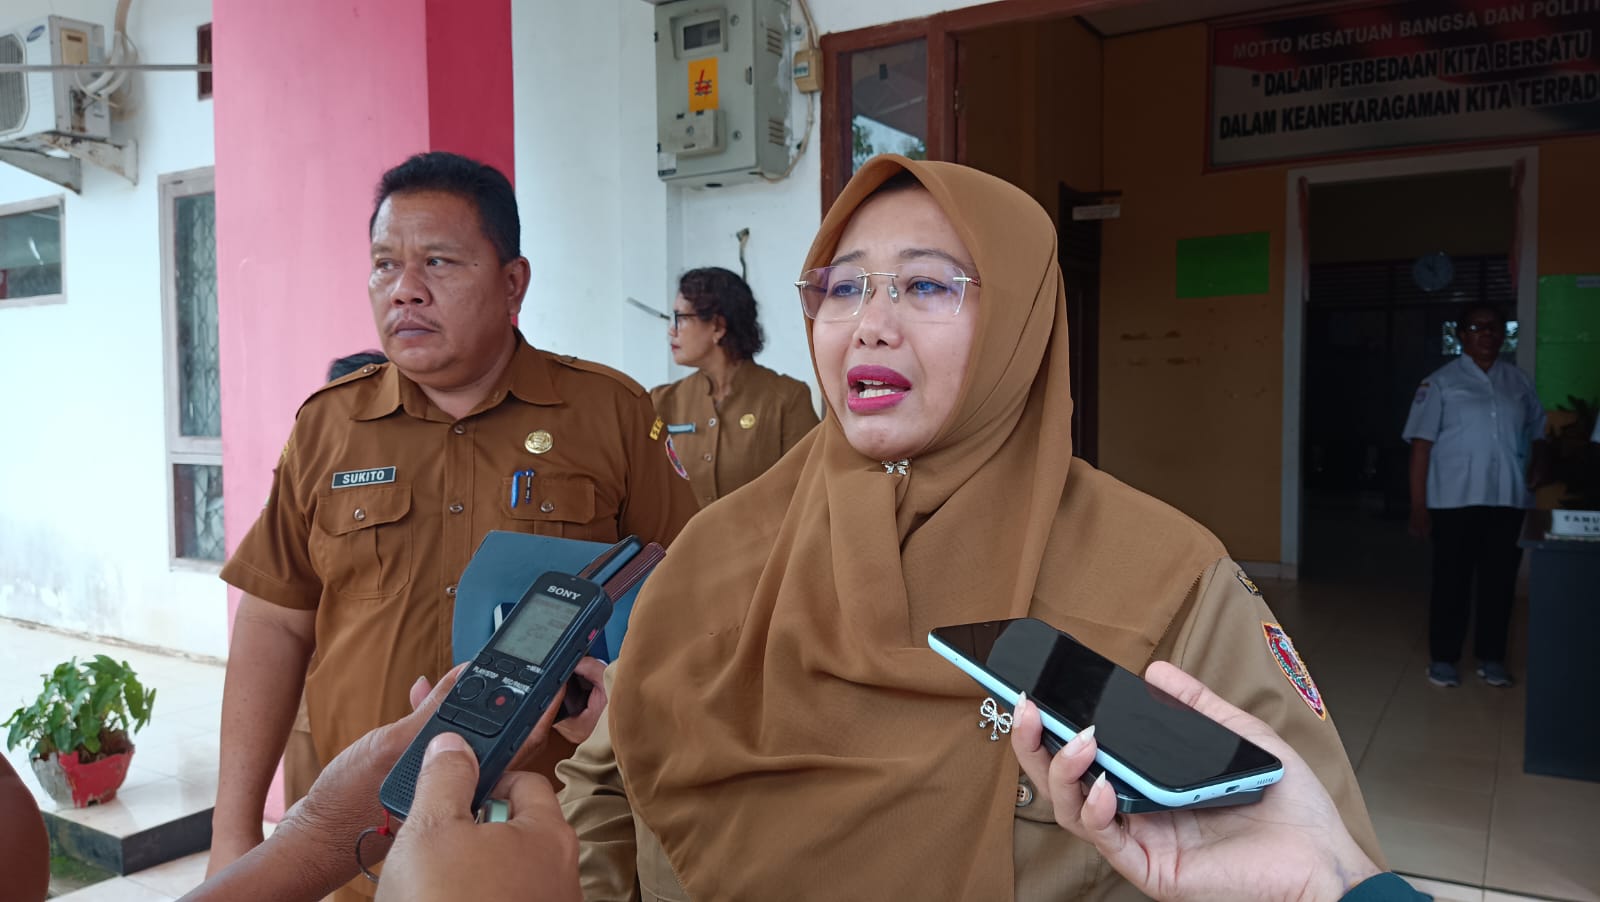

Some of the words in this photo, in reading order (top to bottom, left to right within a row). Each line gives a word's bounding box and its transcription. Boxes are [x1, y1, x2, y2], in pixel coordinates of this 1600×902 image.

[1232, 37, 1293, 60] MOTTO
[1297, 23, 1393, 52] KESATUAN
[1399, 11, 1479, 37] BANGSA
[1484, 5, 1525, 26] DAN
[1329, 53, 1438, 88] PERBEDAAN
[1444, 46, 1489, 74] KITA
[1495, 32, 1591, 68] BERSATU
[1219, 110, 1277, 139] DALAM
[1282, 88, 1460, 132] KEANEKARAGAMAN
[1466, 82, 1513, 112] KITA
[1518, 74, 1600, 106] TERPAD
[342, 470, 385, 485] SUKITO
[547, 585, 581, 600] SONY
